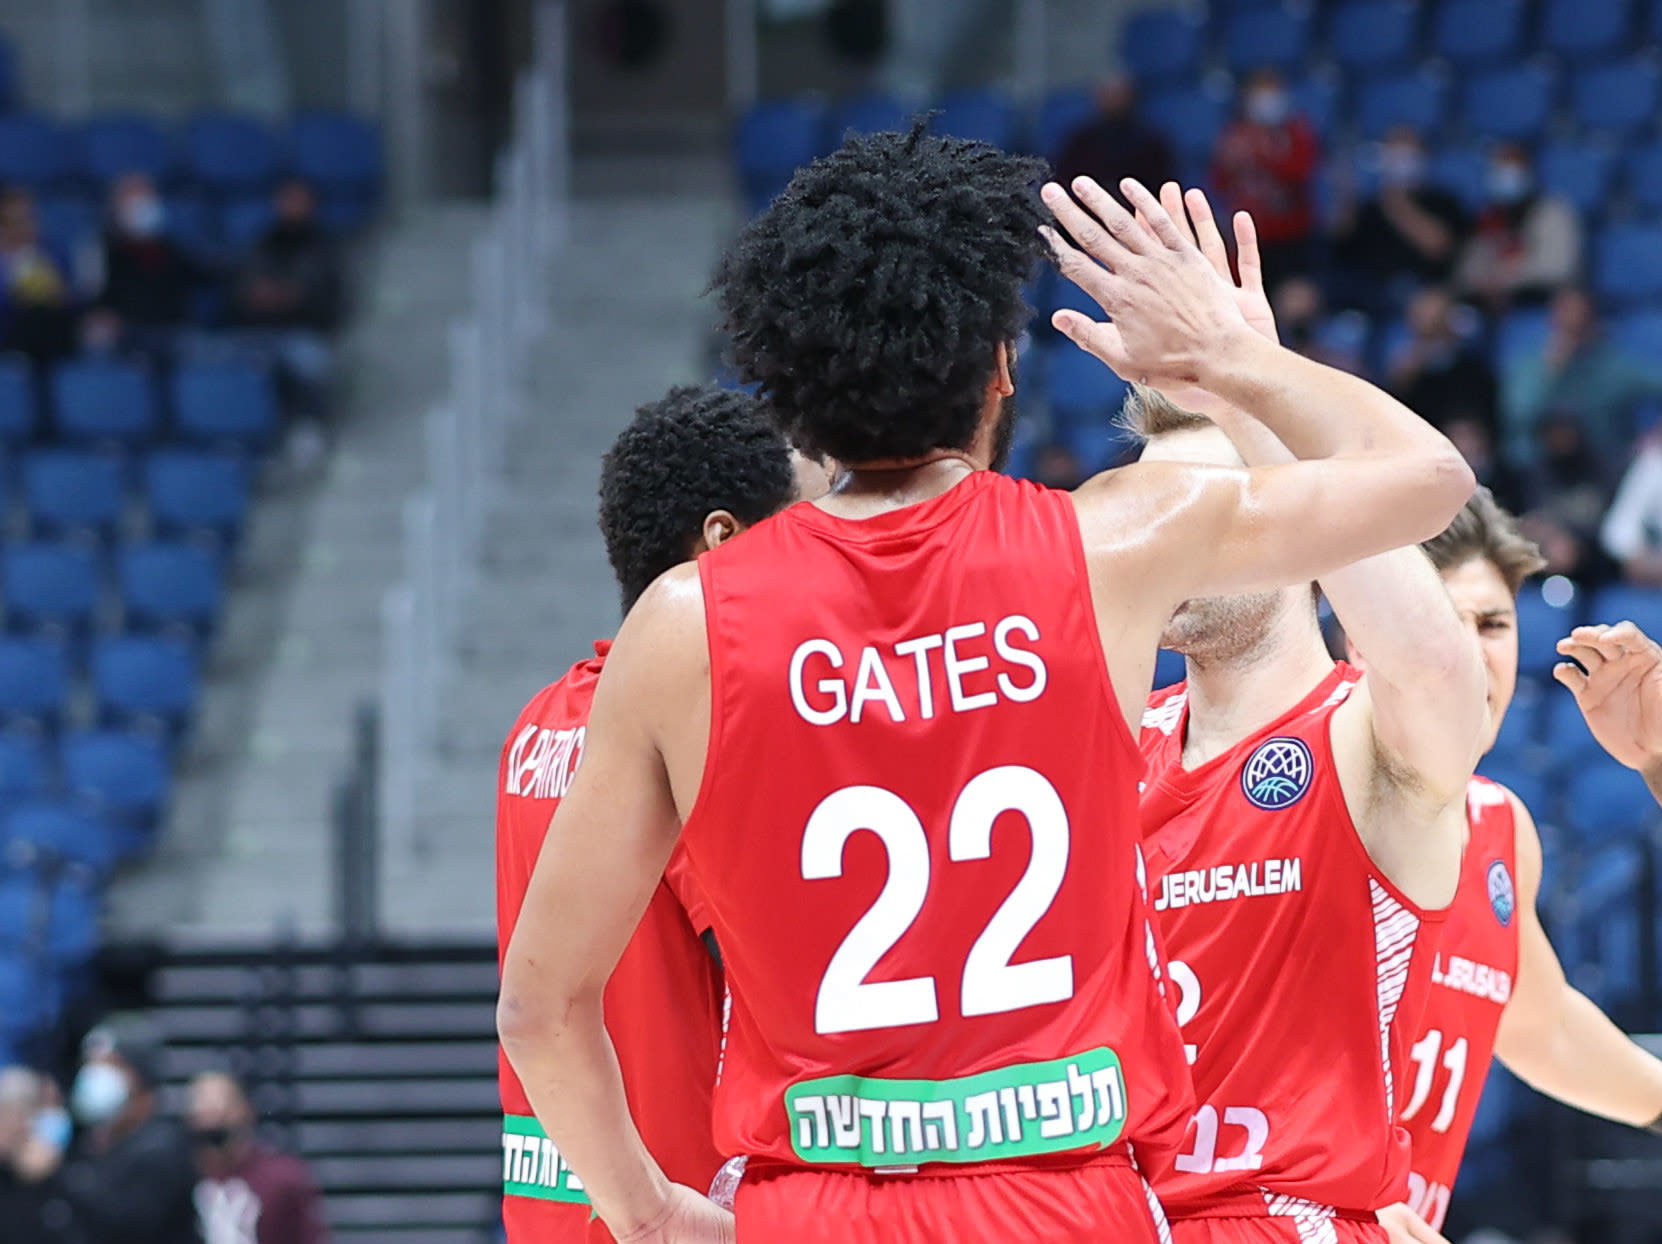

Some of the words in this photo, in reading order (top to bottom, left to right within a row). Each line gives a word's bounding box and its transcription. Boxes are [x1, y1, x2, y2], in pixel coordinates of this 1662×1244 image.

[788, 614, 1048, 726] GATES
[800, 764, 1075, 1035] 22
[1154, 857, 1302, 911] JERUSALEM
[793, 1094, 959, 1154] החדשה
[965, 1063, 1124, 1148] תלפיות
[1399, 1029, 1469, 1133] 11
